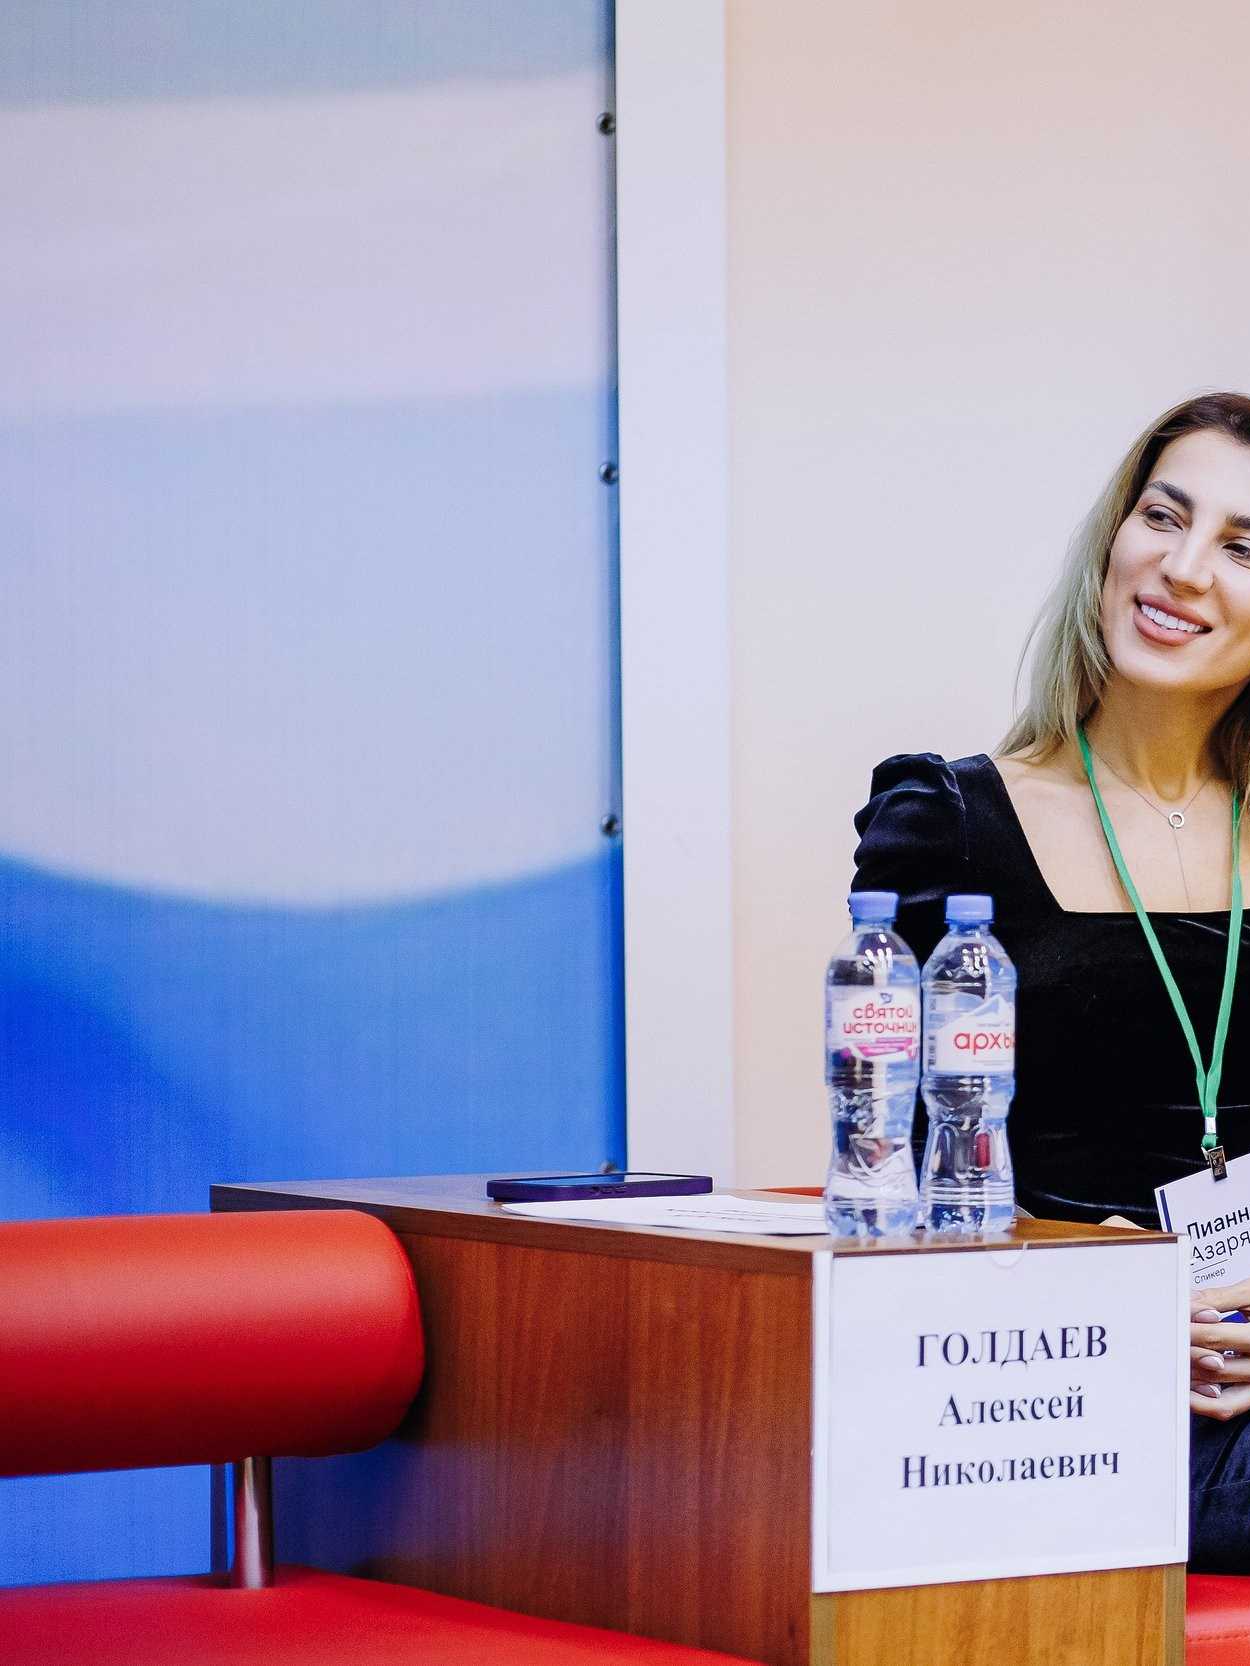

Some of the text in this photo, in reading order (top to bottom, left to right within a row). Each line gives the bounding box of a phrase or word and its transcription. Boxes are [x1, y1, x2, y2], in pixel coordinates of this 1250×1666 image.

[1194, 1268, 1226, 1284] Спикер
[917, 1325, 1108, 1370] ГОЛДАЕВ
[939, 1386, 1084, 1426] Алексей
[902, 1452, 1120, 1489] Николаевич
